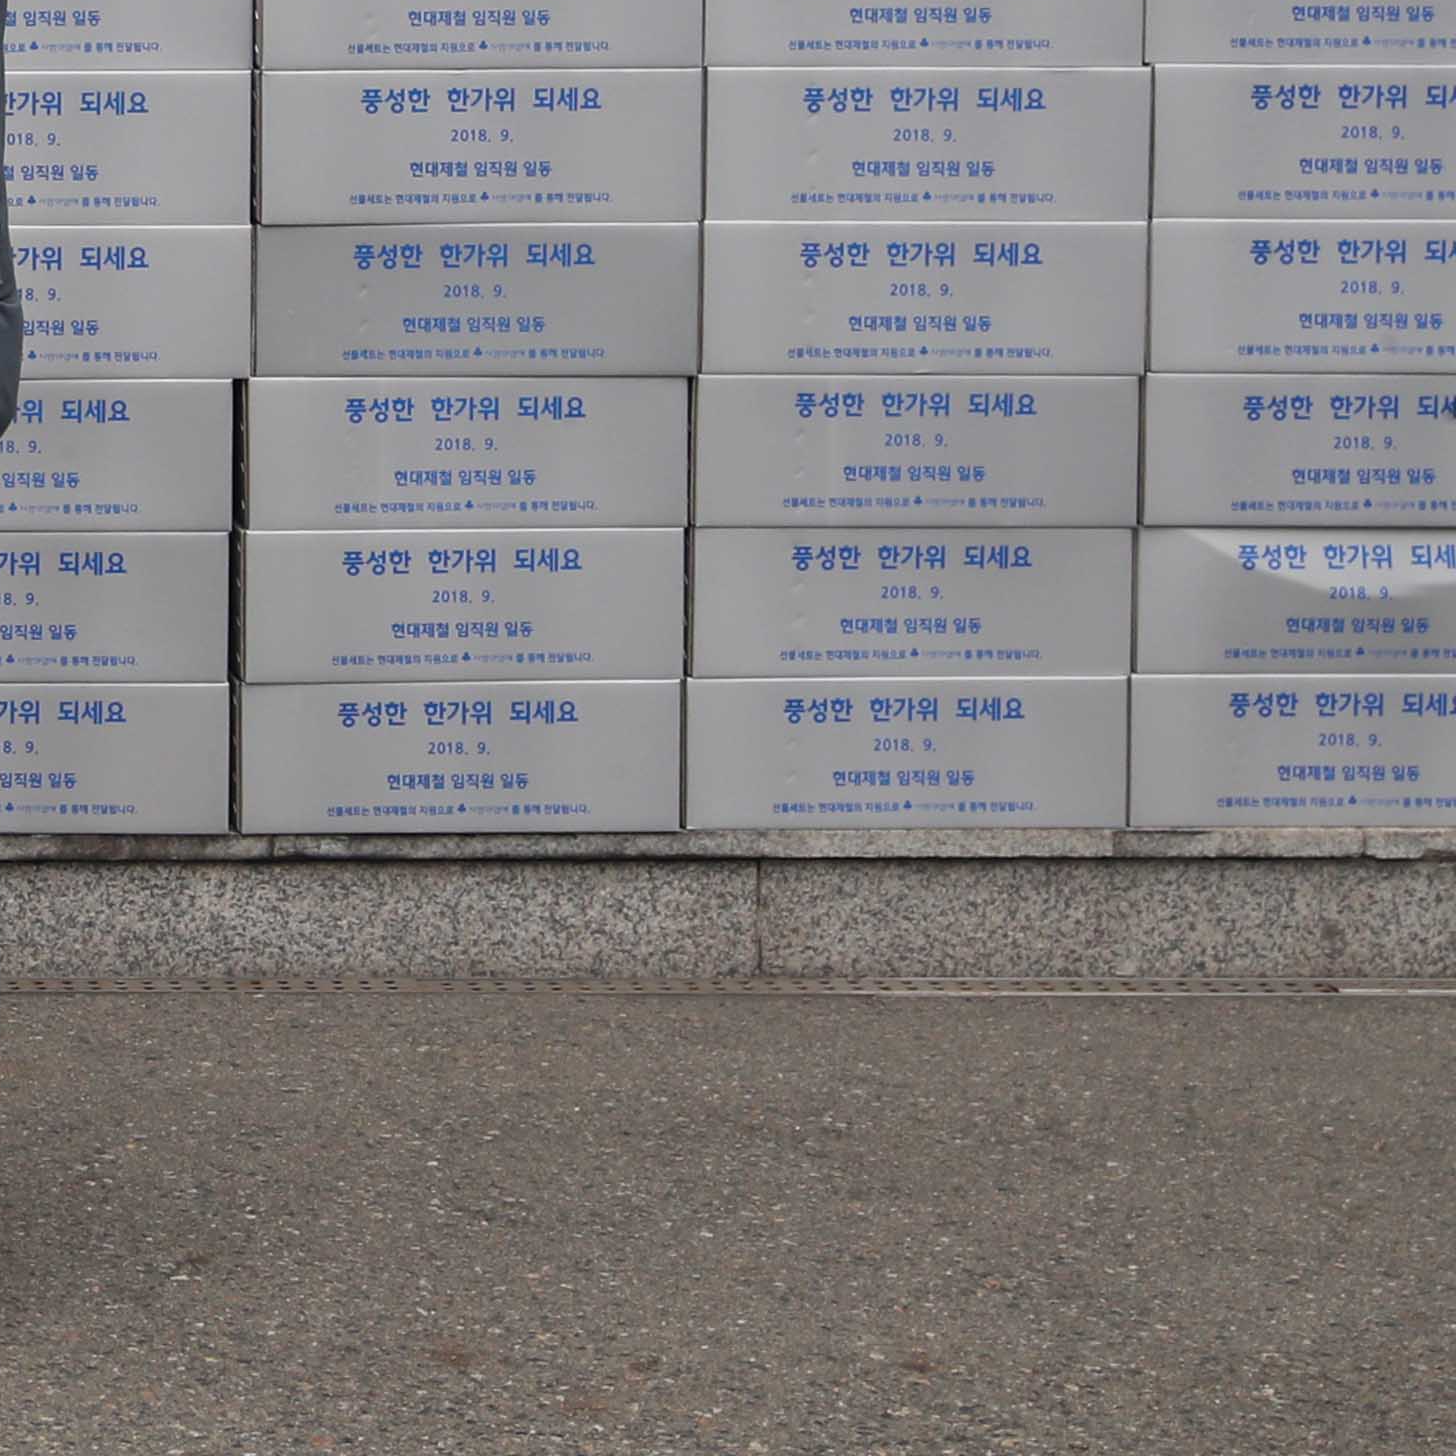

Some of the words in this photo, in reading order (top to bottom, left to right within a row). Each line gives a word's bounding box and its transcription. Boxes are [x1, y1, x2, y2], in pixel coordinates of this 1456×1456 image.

[850, 8, 908, 24] 현대제철
[914, 6, 957, 24] 임직원
[964, 6, 992, 23] 일동
[342, 549, 412, 576] 풍성한
[428, 547, 497, 575] 한가위
[514, 546, 582, 572] 되세요
[392, 623, 450, 639] 현대제철
[456, 621, 499, 638] 임직원
[505, 620, 533, 638] 일동
[783, 697, 853, 723] 풍성한
[870, 696, 938, 723] 한가위
[956, 695, 1025, 721] 되세요
[833, 771, 892, 787] 현대제철
[897, 769, 940, 787] 임직원
[947, 769, 975, 786] 일동
